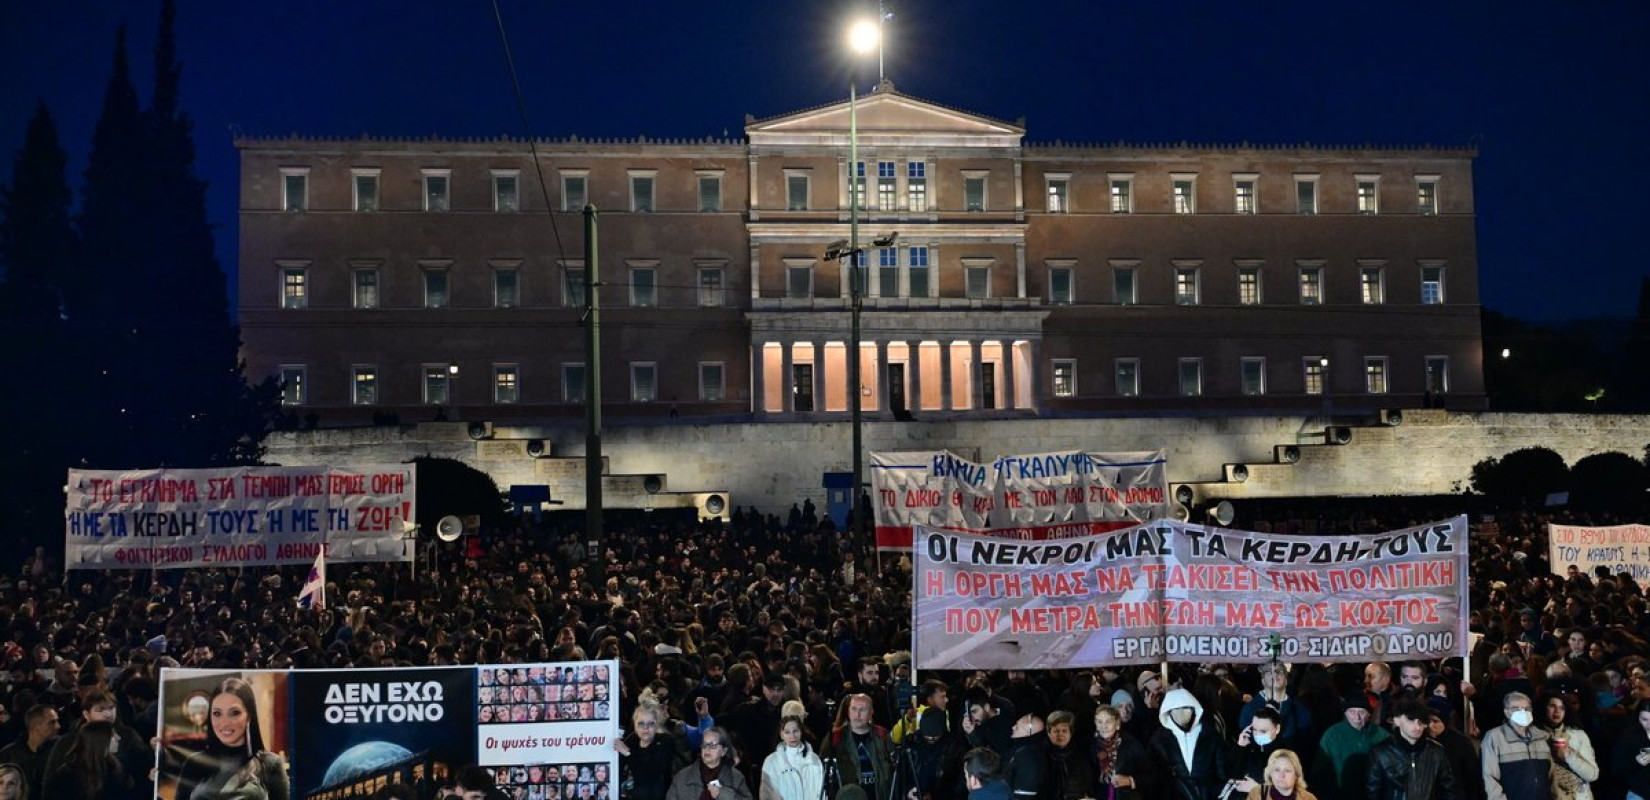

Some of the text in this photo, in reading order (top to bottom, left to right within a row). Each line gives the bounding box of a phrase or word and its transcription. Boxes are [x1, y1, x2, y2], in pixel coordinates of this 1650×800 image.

[994, 453, 1095, 479] ΥΓΚΑΛΥΨΗ
[91, 479, 113, 503] ΤΟ
[120, 478, 198, 504] ΕΓΚΛΗΜΑ
[208, 478, 235, 500] ΣΤΑ
[242, 475, 290, 497] ΤΕΜΠΗ
[296, 475, 324, 496] ΜΑΣ
[371, 473, 404, 494] ΟΡΓΗ
[880, 489, 896, 508] ΤΟ
[905, 489, 941, 508] ΔΙΚΙΟ
[1004, 491, 1023, 509] ΜΕ
[1034, 490, 1057, 507] ΤΟΝ
[1089, 486, 1118, 504] ΣΤΟΝ
[84, 512, 104, 537] ΜΕ
[109, 513, 127, 537] ΤΑ
[134, 512, 197, 537] ΚΕΡΔΗ
[207, 510, 259, 534] ΤΟΥΣ
[292, 509, 319, 532] ΜΕ
[328, 508, 349, 531] ΤΗ
[115, 547, 193, 565] ΦΟΙΤΗΤΙΚΟΙ
[202, 543, 267, 562] ΣΥΛΛΟΓΟΙ
[927, 532, 957, 563] ΟΙ
[971, 540, 1096, 566] ΝΕΚΡΟΙ
[1106, 527, 1173, 561] ΜΑΣ
[1184, 530, 1228, 558] ΤΑ
[1241, 537, 1361, 564] ΚΕΡΔΗ
[1372, 524, 1453, 559] ΤΟΥΣ
[1558, 546, 1581, 562] ΤΟΥ
[926, 560, 1454, 598] Η ΟΡΓΗ ΜΑΣ ΝΑ ΤΣΑΚΙΣΕΙ ΤΗΝ ΠΟΛΙΤΙΚΗ
[946, 597, 1441, 635] ΠΟΥ ΜΕΤΡΑ ΤΗΝ ΖΩΗ ΜΑΣ ΩΣ ΚΟΣΤΟΣ
[1113, 634, 1248, 659] ΕΡΓΑΟΜΕΝΟΙ
[1308, 631, 1455, 658] ΣΙΔΗΡΟΔΡΟΜΟ
[324, 681, 444, 705] ΔΕΝ ΕΧΩ
[325, 703, 444, 723] ΟΞΥΓΟΝΟ
[485, 733, 606, 752] Οι ψυχές του τρένου
